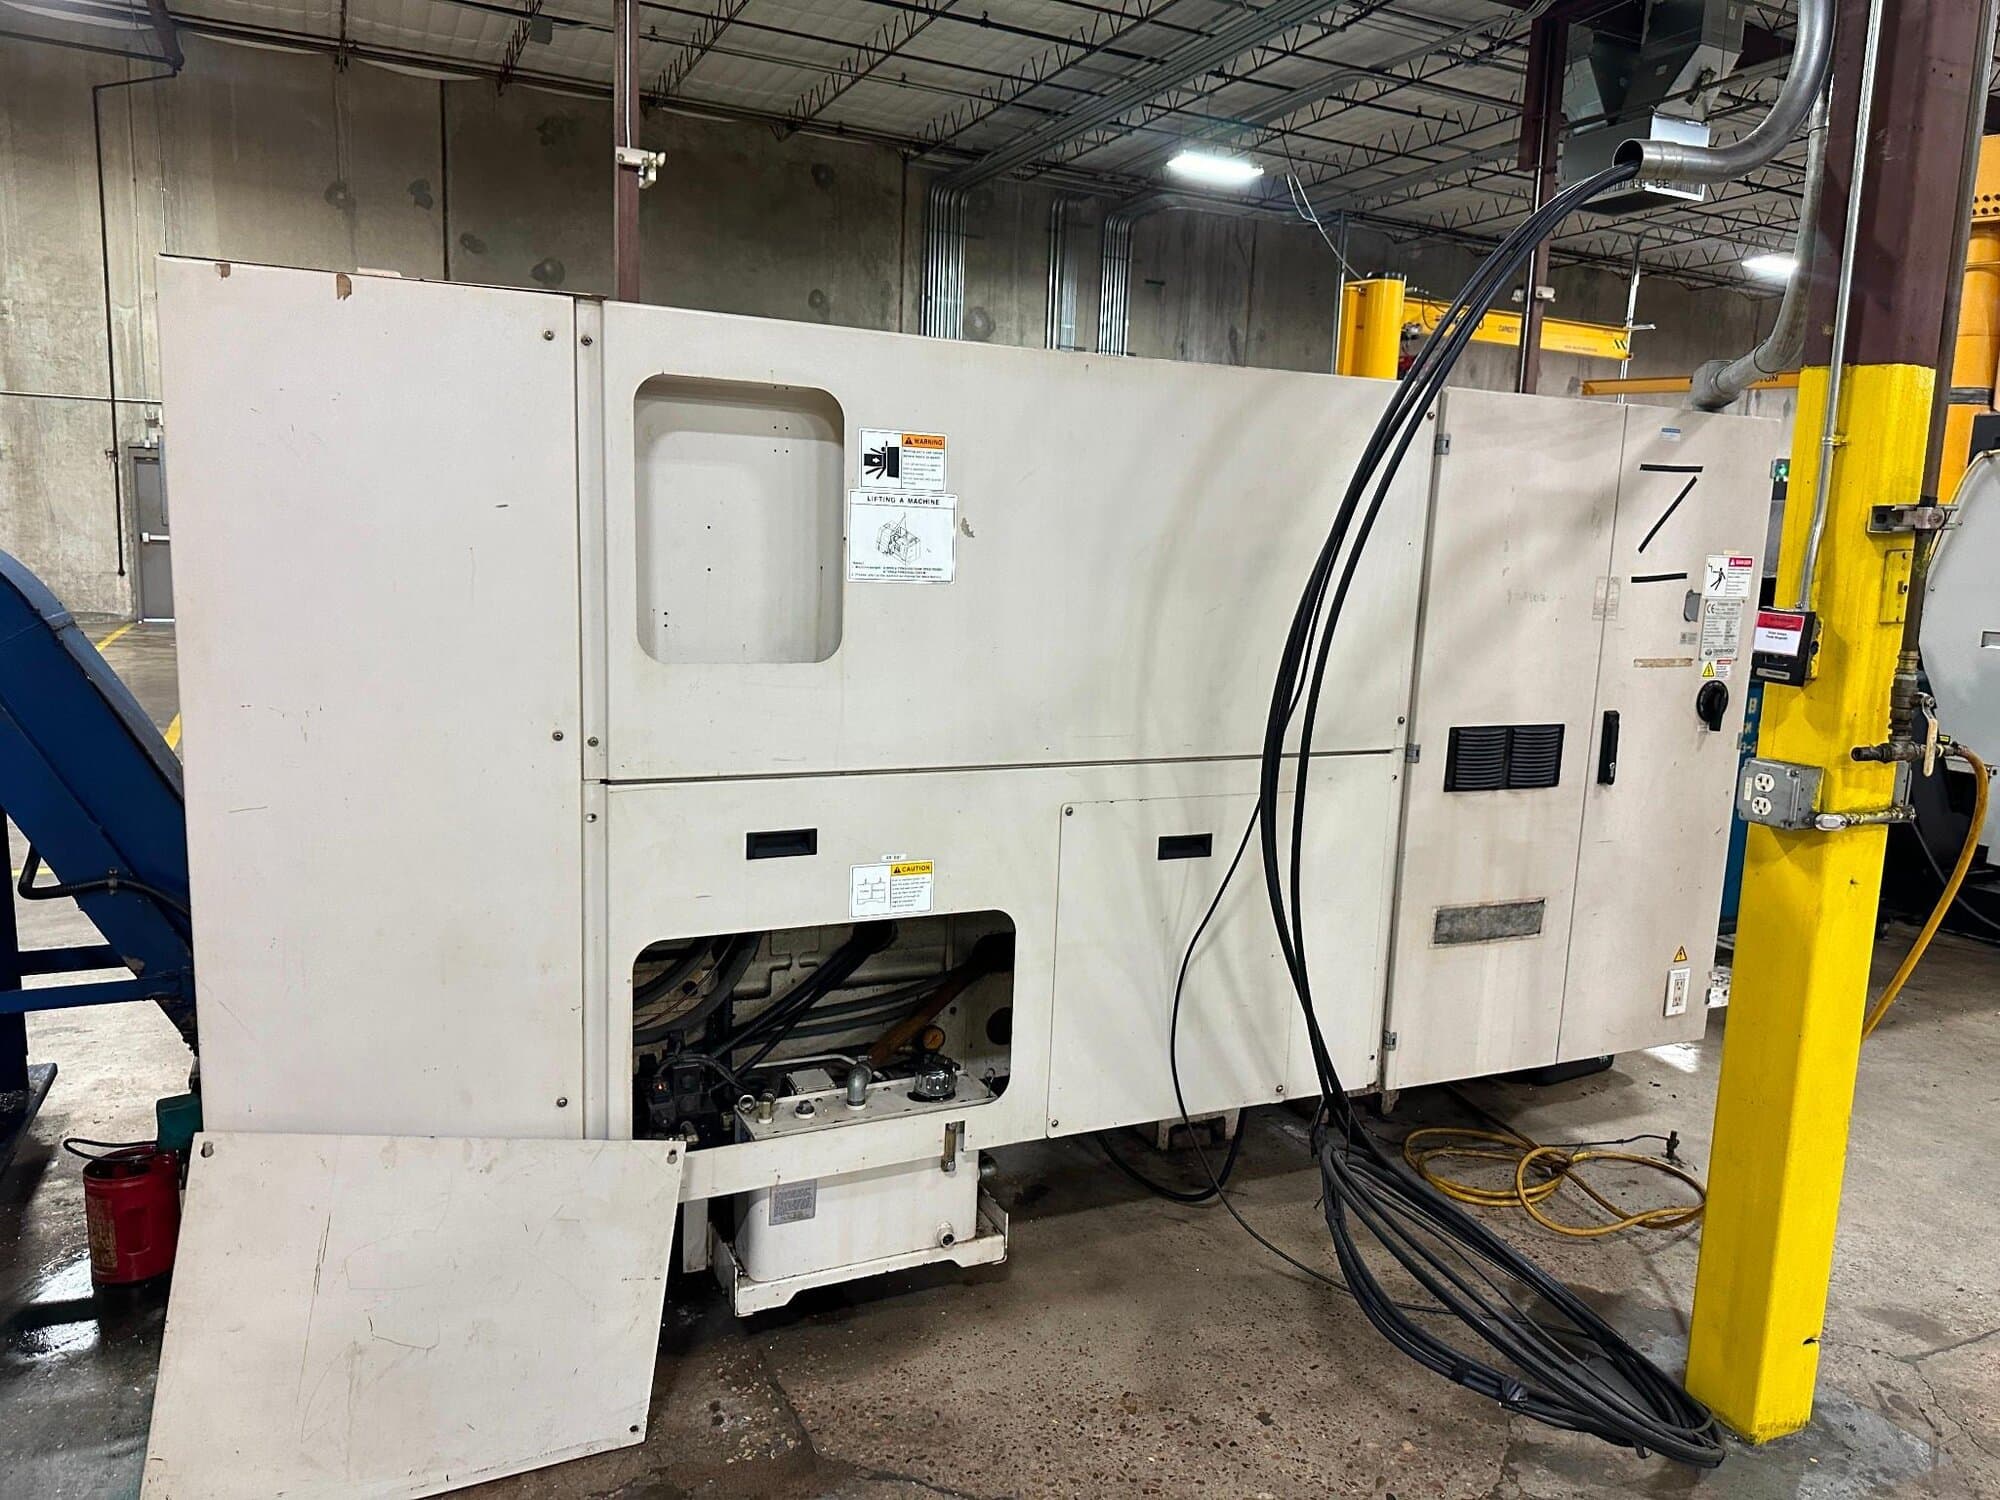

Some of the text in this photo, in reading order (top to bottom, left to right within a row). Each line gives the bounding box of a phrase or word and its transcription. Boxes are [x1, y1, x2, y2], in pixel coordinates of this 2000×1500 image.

[914, 438, 943, 446] WARNING
[867, 495, 896, 504] LIFTING
[907, 497, 940, 506] MACHINE
[902, 865, 930, 873] CAUTION
